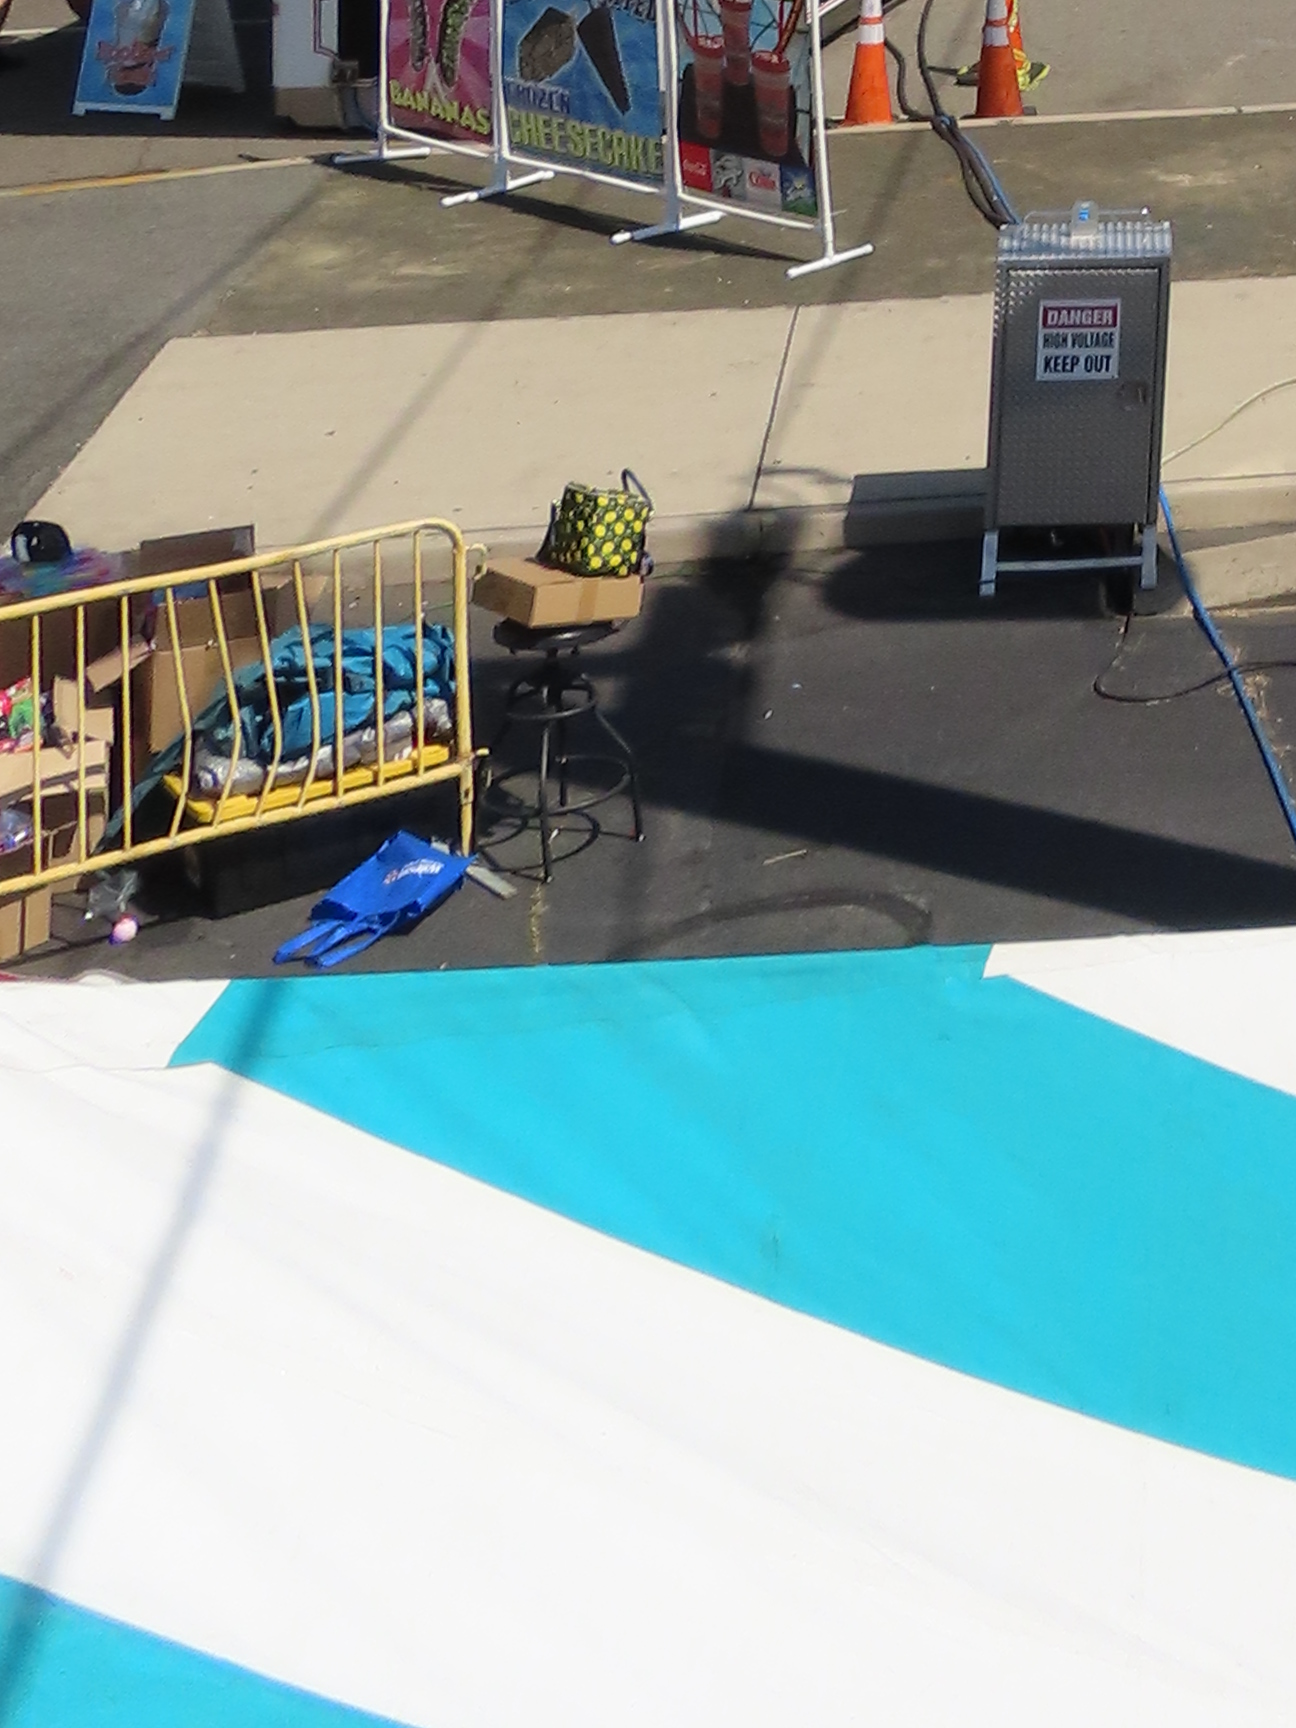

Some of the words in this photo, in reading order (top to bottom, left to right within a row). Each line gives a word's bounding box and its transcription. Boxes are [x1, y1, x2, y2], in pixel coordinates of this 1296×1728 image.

[389, 79, 490, 135] BANANAS
[508, 104, 663, 175] CHEESECAKE
[1046, 308, 1113, 326] DANGER
[1042, 332, 1068, 349] HIGH
[1070, 331, 1115, 349] VOLTAGE
[1043, 354, 1080, 373] KEEP
[1084, 354, 1112, 373] OUT
